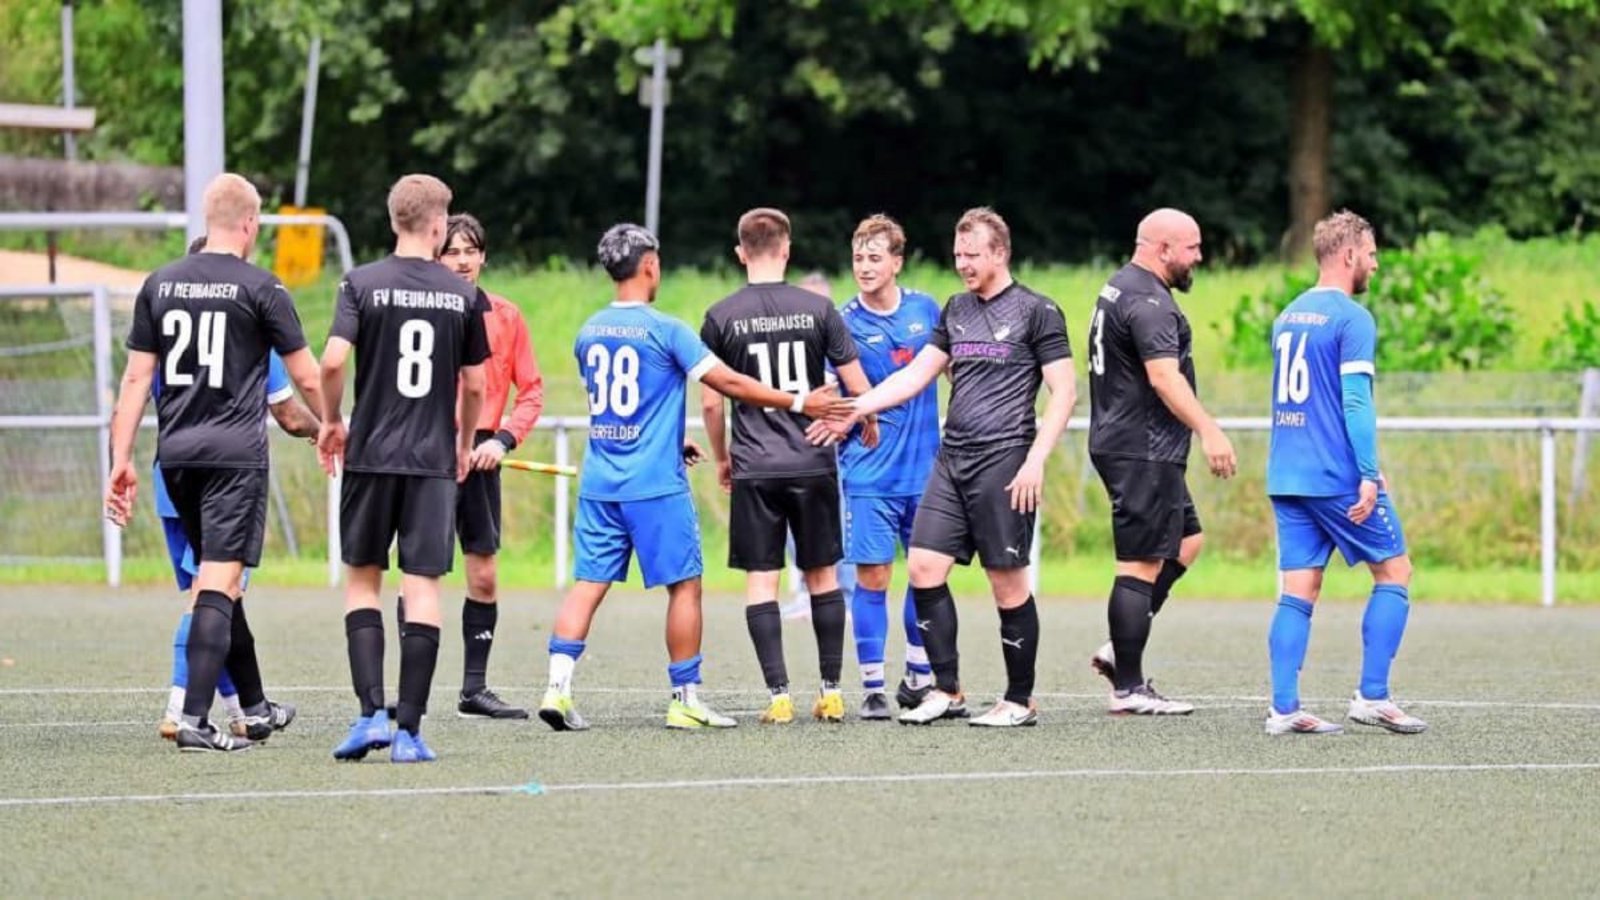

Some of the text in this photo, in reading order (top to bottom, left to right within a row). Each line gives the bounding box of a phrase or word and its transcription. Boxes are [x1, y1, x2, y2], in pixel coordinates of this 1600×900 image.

[159, 282, 239, 300] FV NEUHAUSEN
[373, 288, 465, 313] FV NEUHAUSEN
[733, 313, 815, 336] FV NEUHAUSEN
[162, 309, 227, 388] 24
[396, 318, 435, 398] 8
[747, 340, 811, 413] 14
[1089, 307, 1105, 375] 3
[1276, 331, 1310, 404] 16
[587, 343, 640, 417] 38
